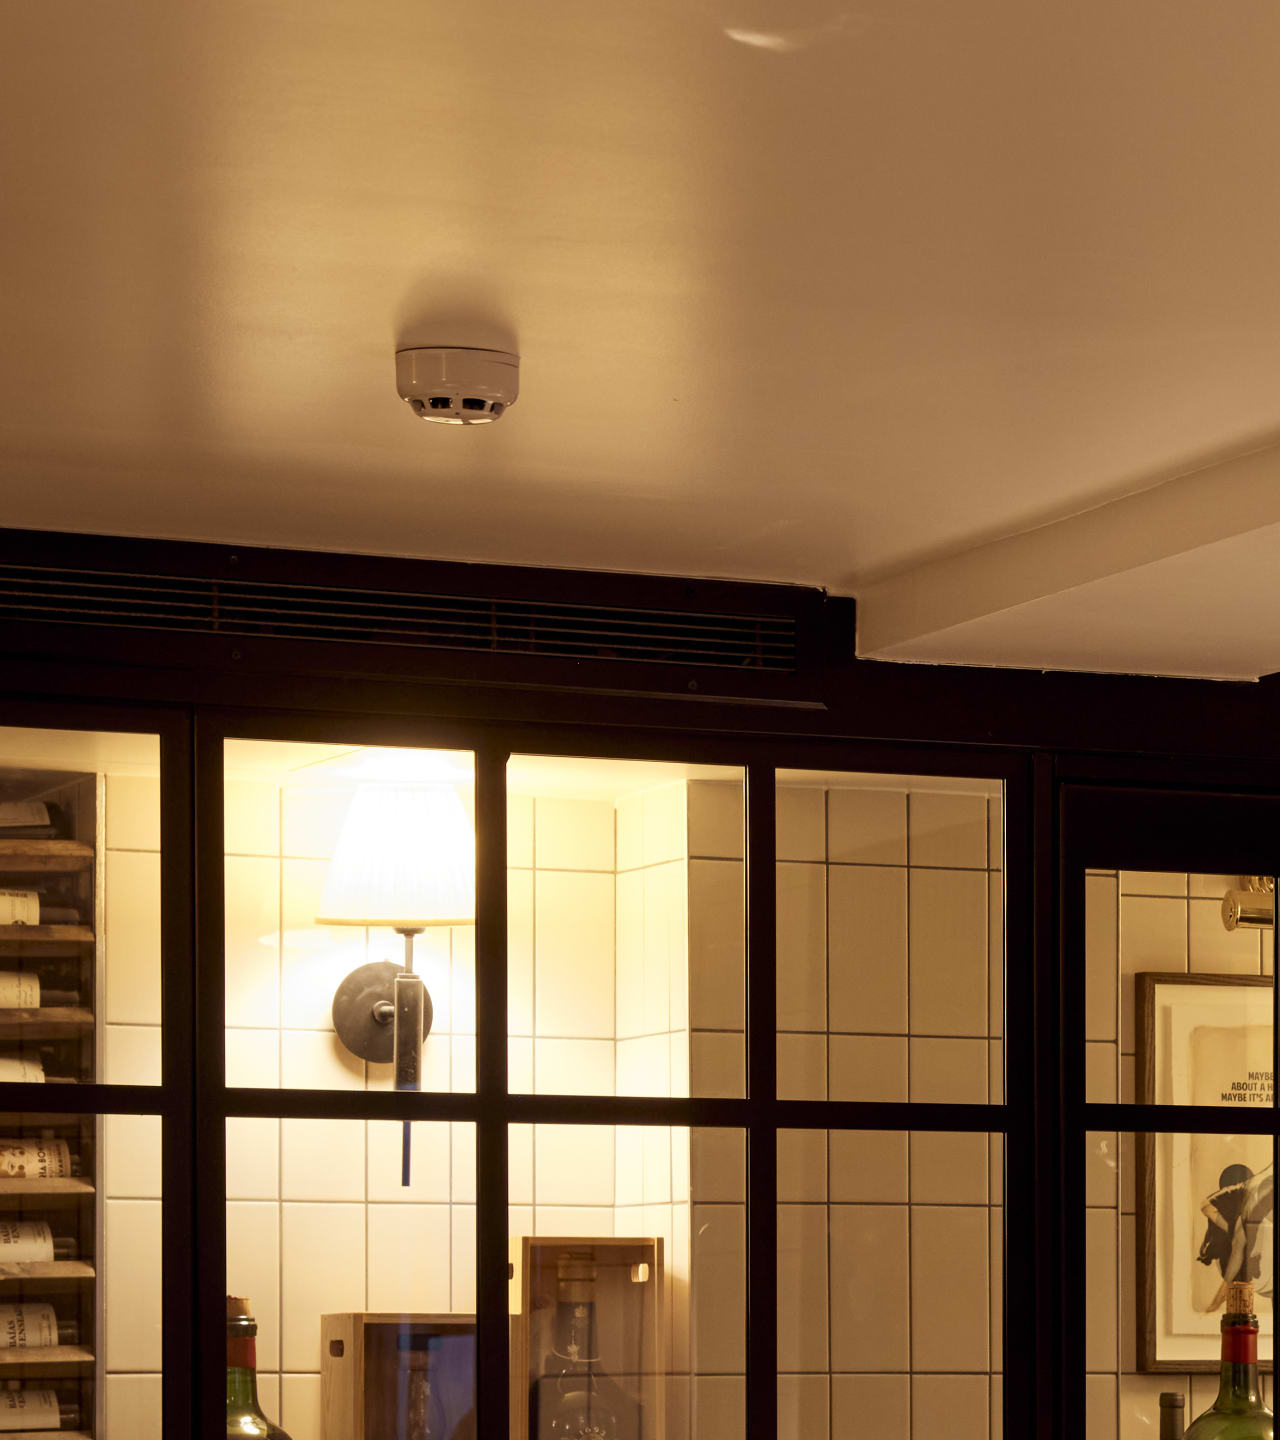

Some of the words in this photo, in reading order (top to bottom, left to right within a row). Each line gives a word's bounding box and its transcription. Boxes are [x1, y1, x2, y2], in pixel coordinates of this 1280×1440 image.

[1231, 1082, 1258, 1091] ABOUT
[1260, 1083, 1266, 1091] A
[1221, 1093, 1247, 1102] MAYBE
[1249, 1093, 1264, 1102] IT'S
